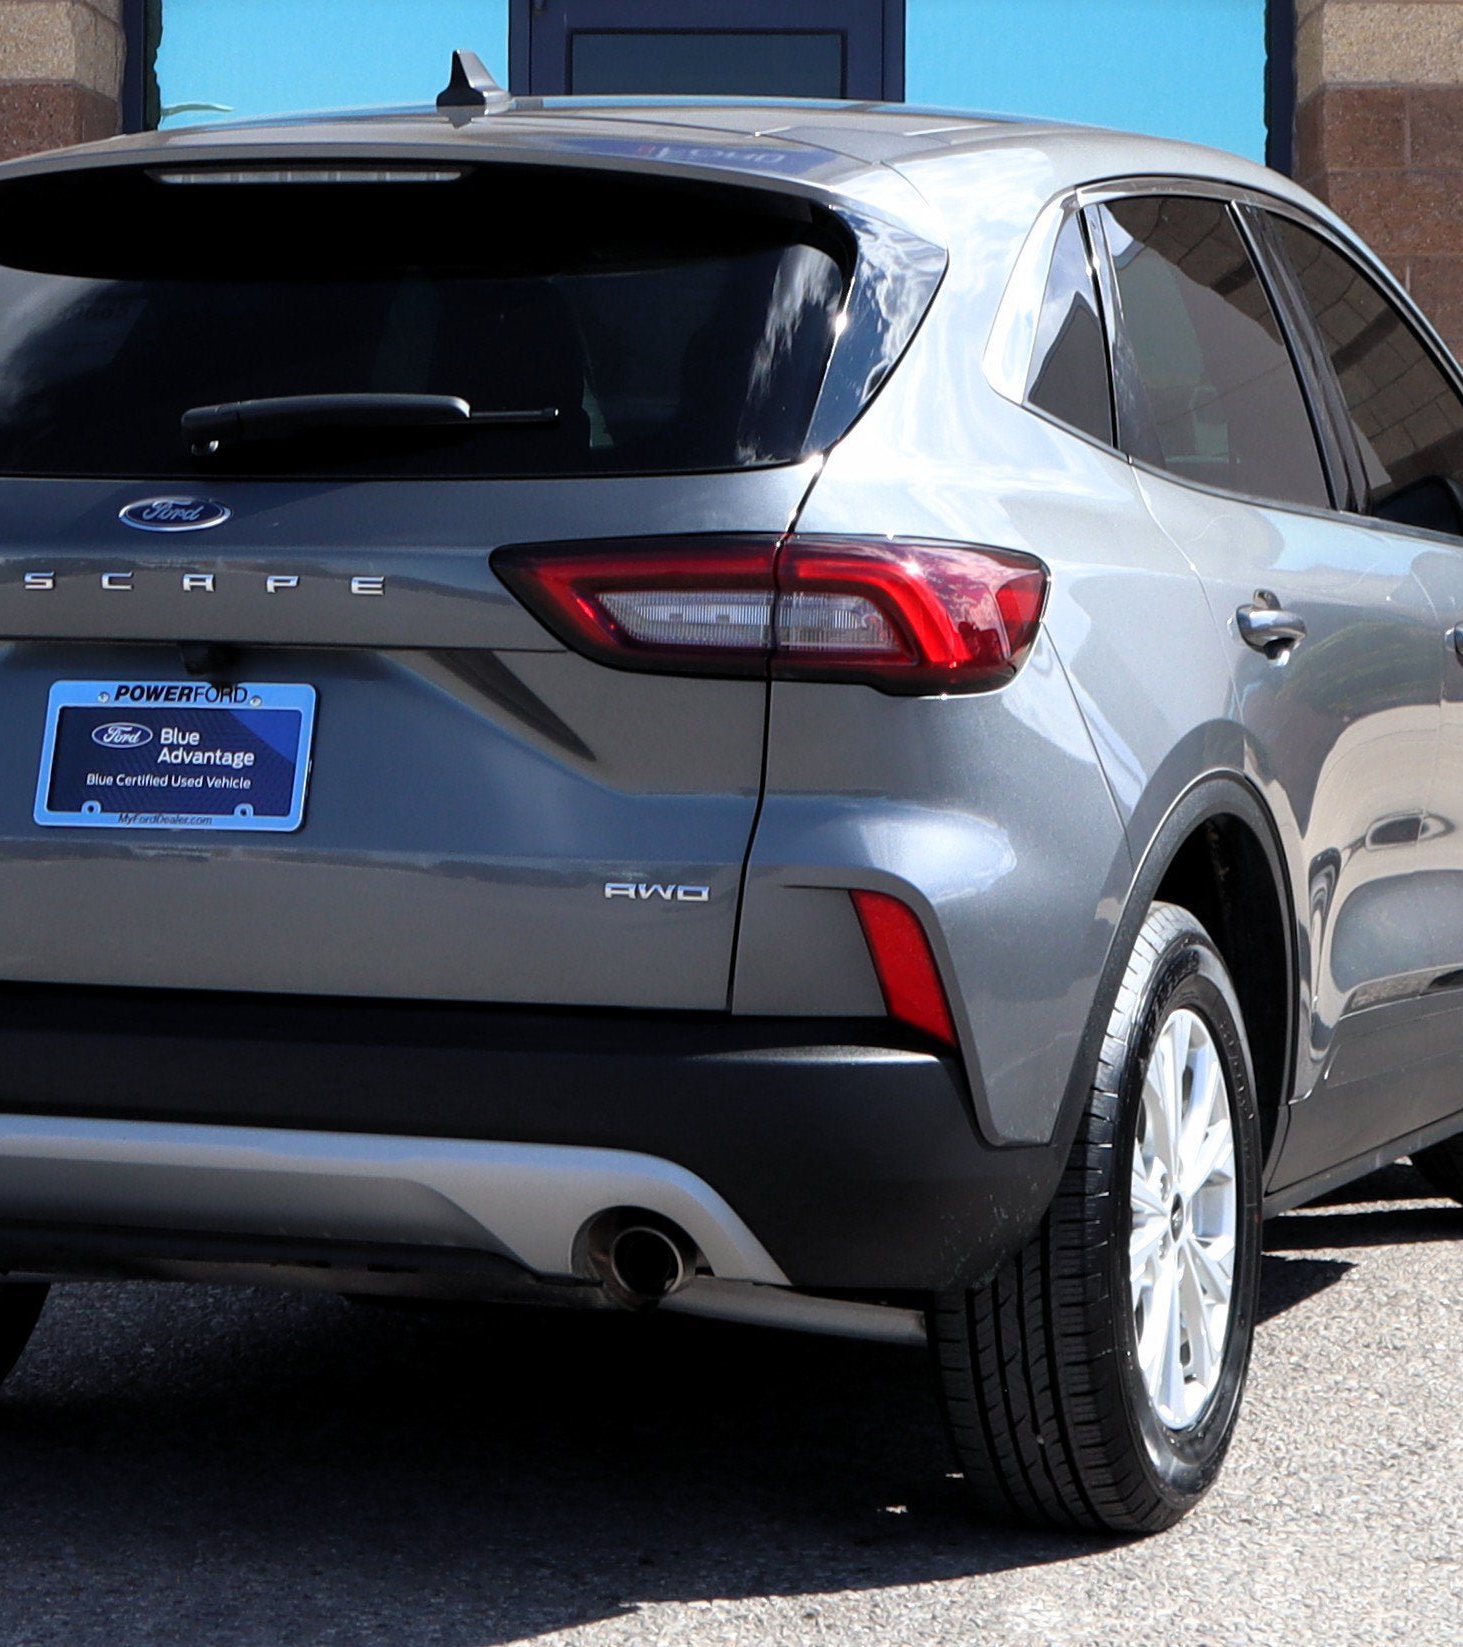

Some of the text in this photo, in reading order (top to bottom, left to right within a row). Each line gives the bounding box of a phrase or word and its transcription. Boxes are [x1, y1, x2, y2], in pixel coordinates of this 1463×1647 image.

[142, 496, 201, 522] Ford
[114, 685, 249, 704] POWERFORD
[102, 726, 142, 744] Ford
[160, 728, 200, 746] Blue
[157, 747, 255, 768] Advantage
[86, 773, 252, 790] Blue Certified Used Vehicle
[118, 812, 213, 826] MyFordDealer.com
[604, 882, 710, 902] AWD
